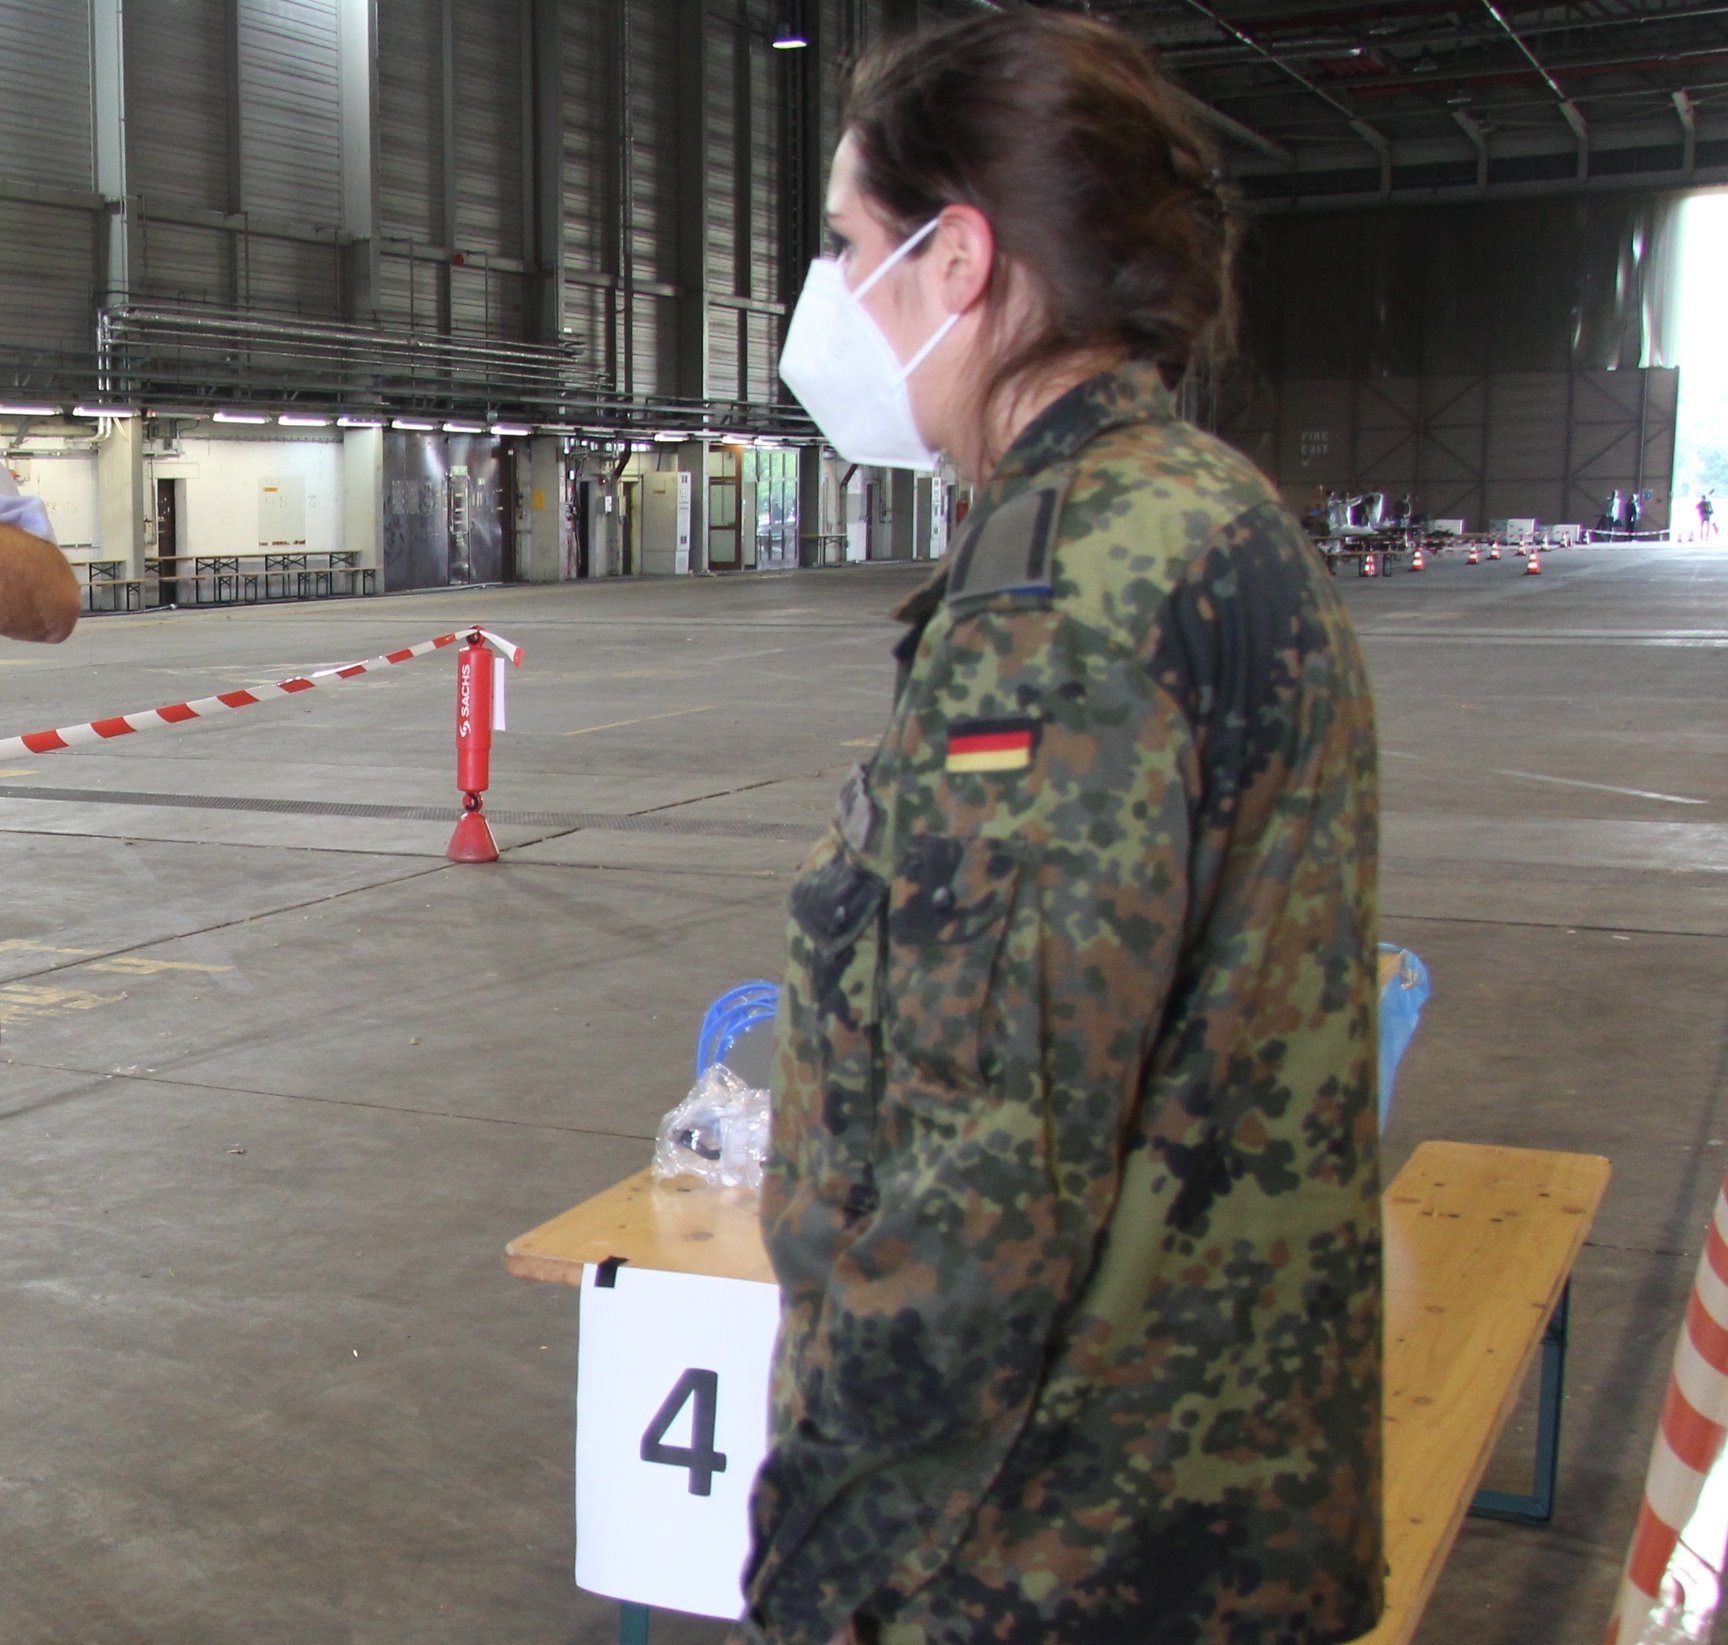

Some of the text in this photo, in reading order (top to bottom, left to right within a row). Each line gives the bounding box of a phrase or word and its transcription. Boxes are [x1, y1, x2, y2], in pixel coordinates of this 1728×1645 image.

[1301, 431, 1329, 442] FIRE
[1301, 444, 1328, 456] EXIT
[461, 664, 471, 718] SACHS
[640, 1367, 727, 1497] 4
